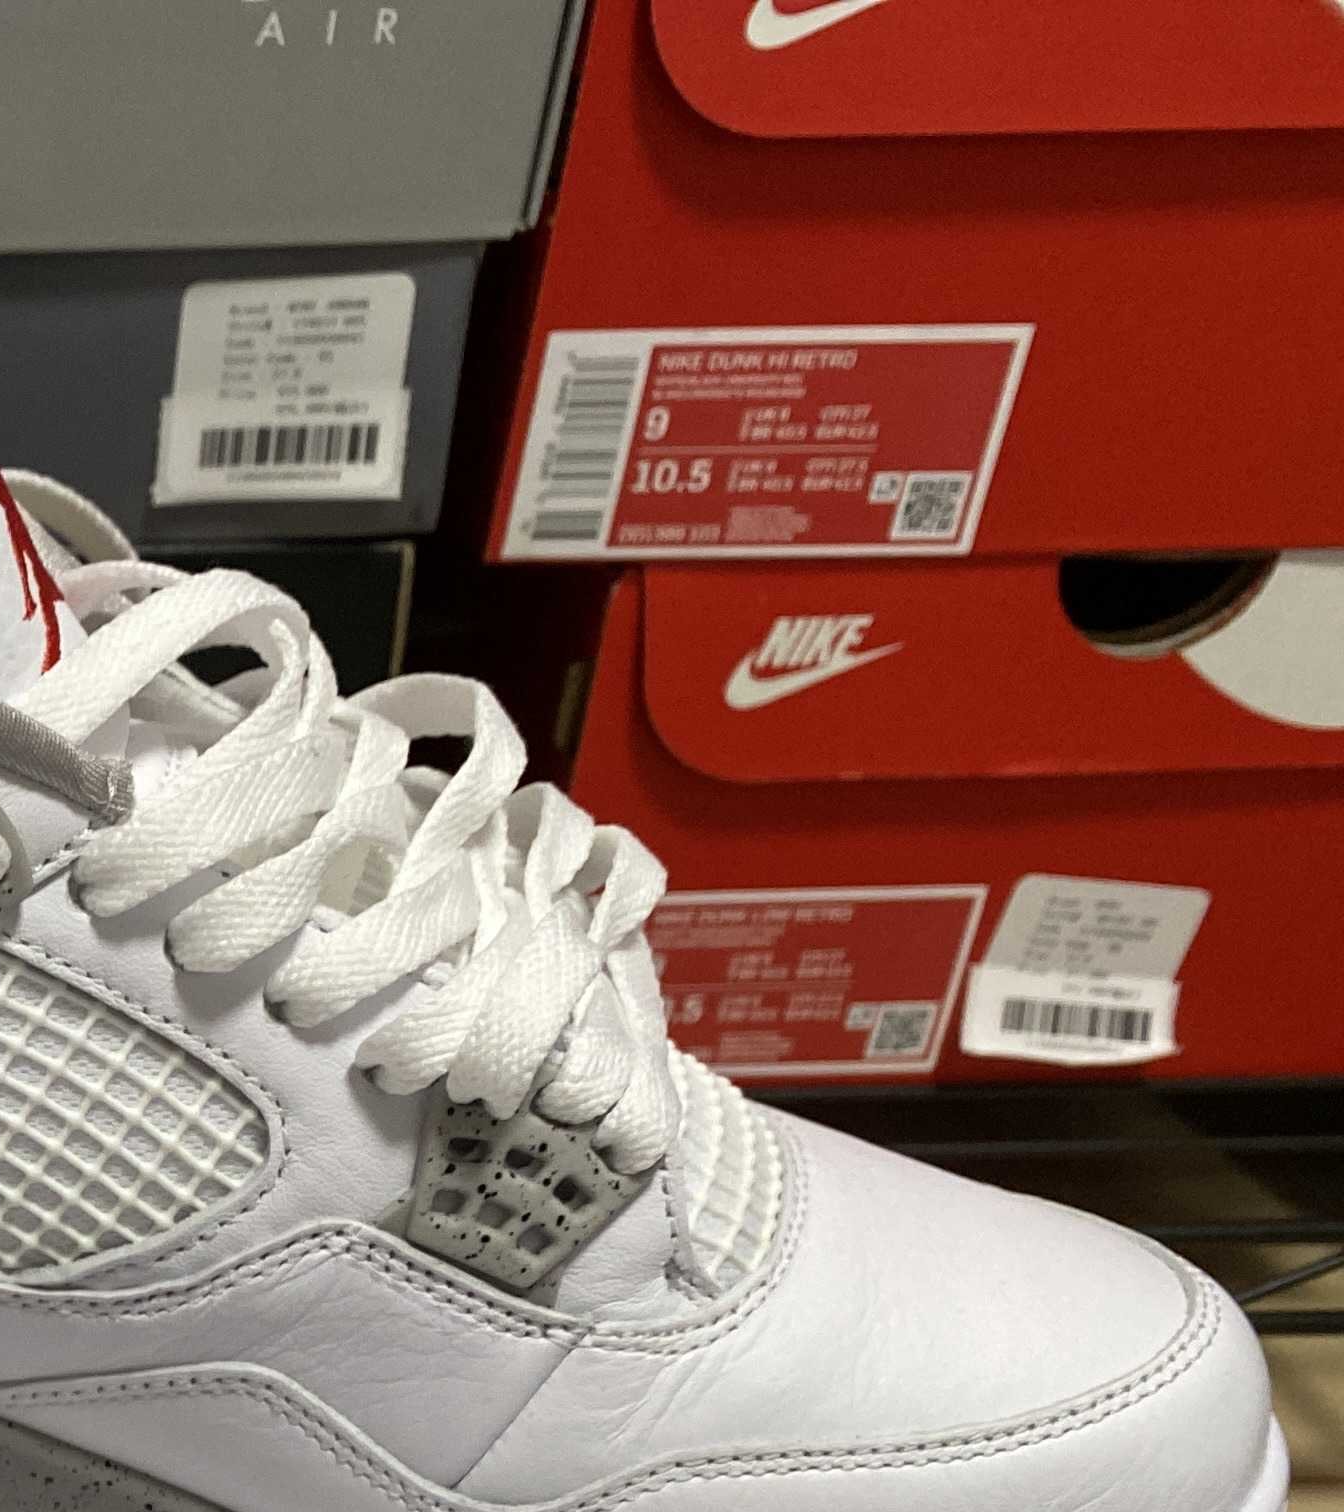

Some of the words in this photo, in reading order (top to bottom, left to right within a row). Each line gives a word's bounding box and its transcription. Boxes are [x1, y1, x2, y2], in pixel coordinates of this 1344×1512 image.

[254, 7, 399, 47] AIR
[643, 404, 671, 442] 9
[631, 457, 713, 493] 10.5
[753, 613, 875, 670] NIKE
